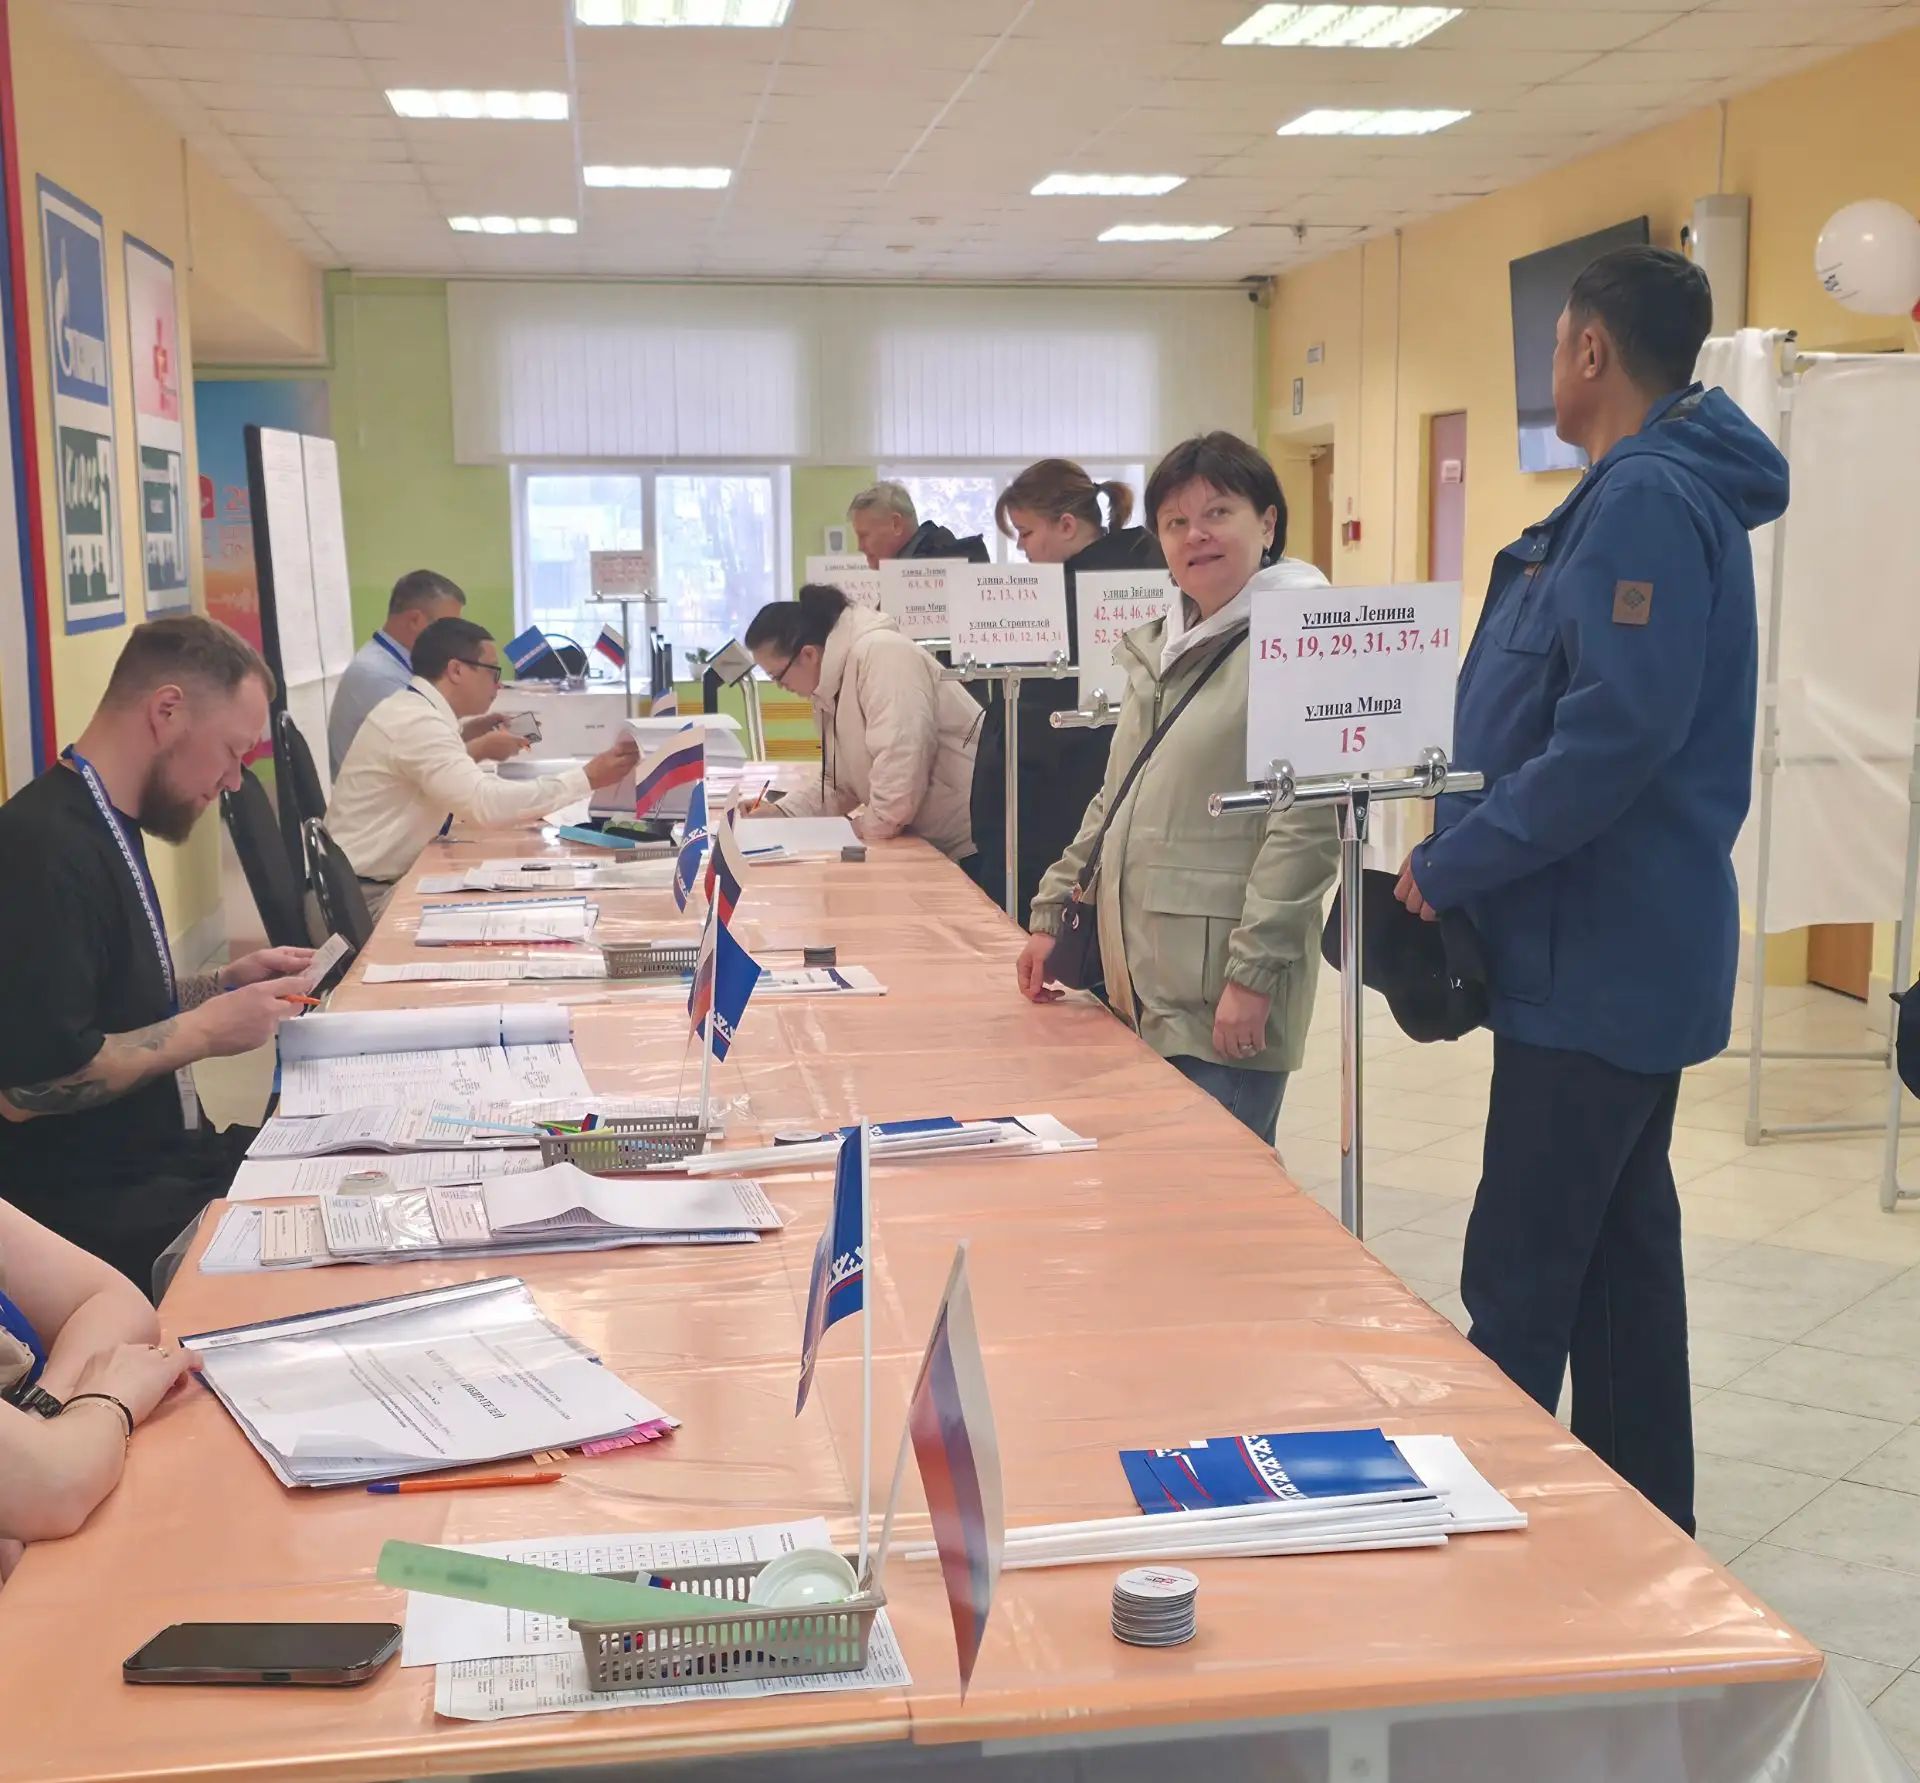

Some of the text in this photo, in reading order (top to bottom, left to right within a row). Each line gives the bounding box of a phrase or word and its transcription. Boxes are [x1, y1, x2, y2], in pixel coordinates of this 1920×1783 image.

[977, 576, 1038, 585] улица Ленина
[981, 589, 996, 600] 12,
[1000, 589, 1014, 600] 13,
[1103, 587, 1164, 600] улица Звёздная
[1094, 606, 1110, 620] 42,
[1113, 606, 1127, 620] 44,
[1130, 605, 1143, 619] 46,
[1302, 605, 1415, 627] улица Ленина
[970, 619, 1050, 630] улица Строителей
[1094, 629, 1110, 643] 52,
[1259, 628, 1450, 663] 15, 19, 29, 31, 37, 41
[1305, 697, 1401, 720] улица Мира
[1340, 726, 1367, 753] 15
